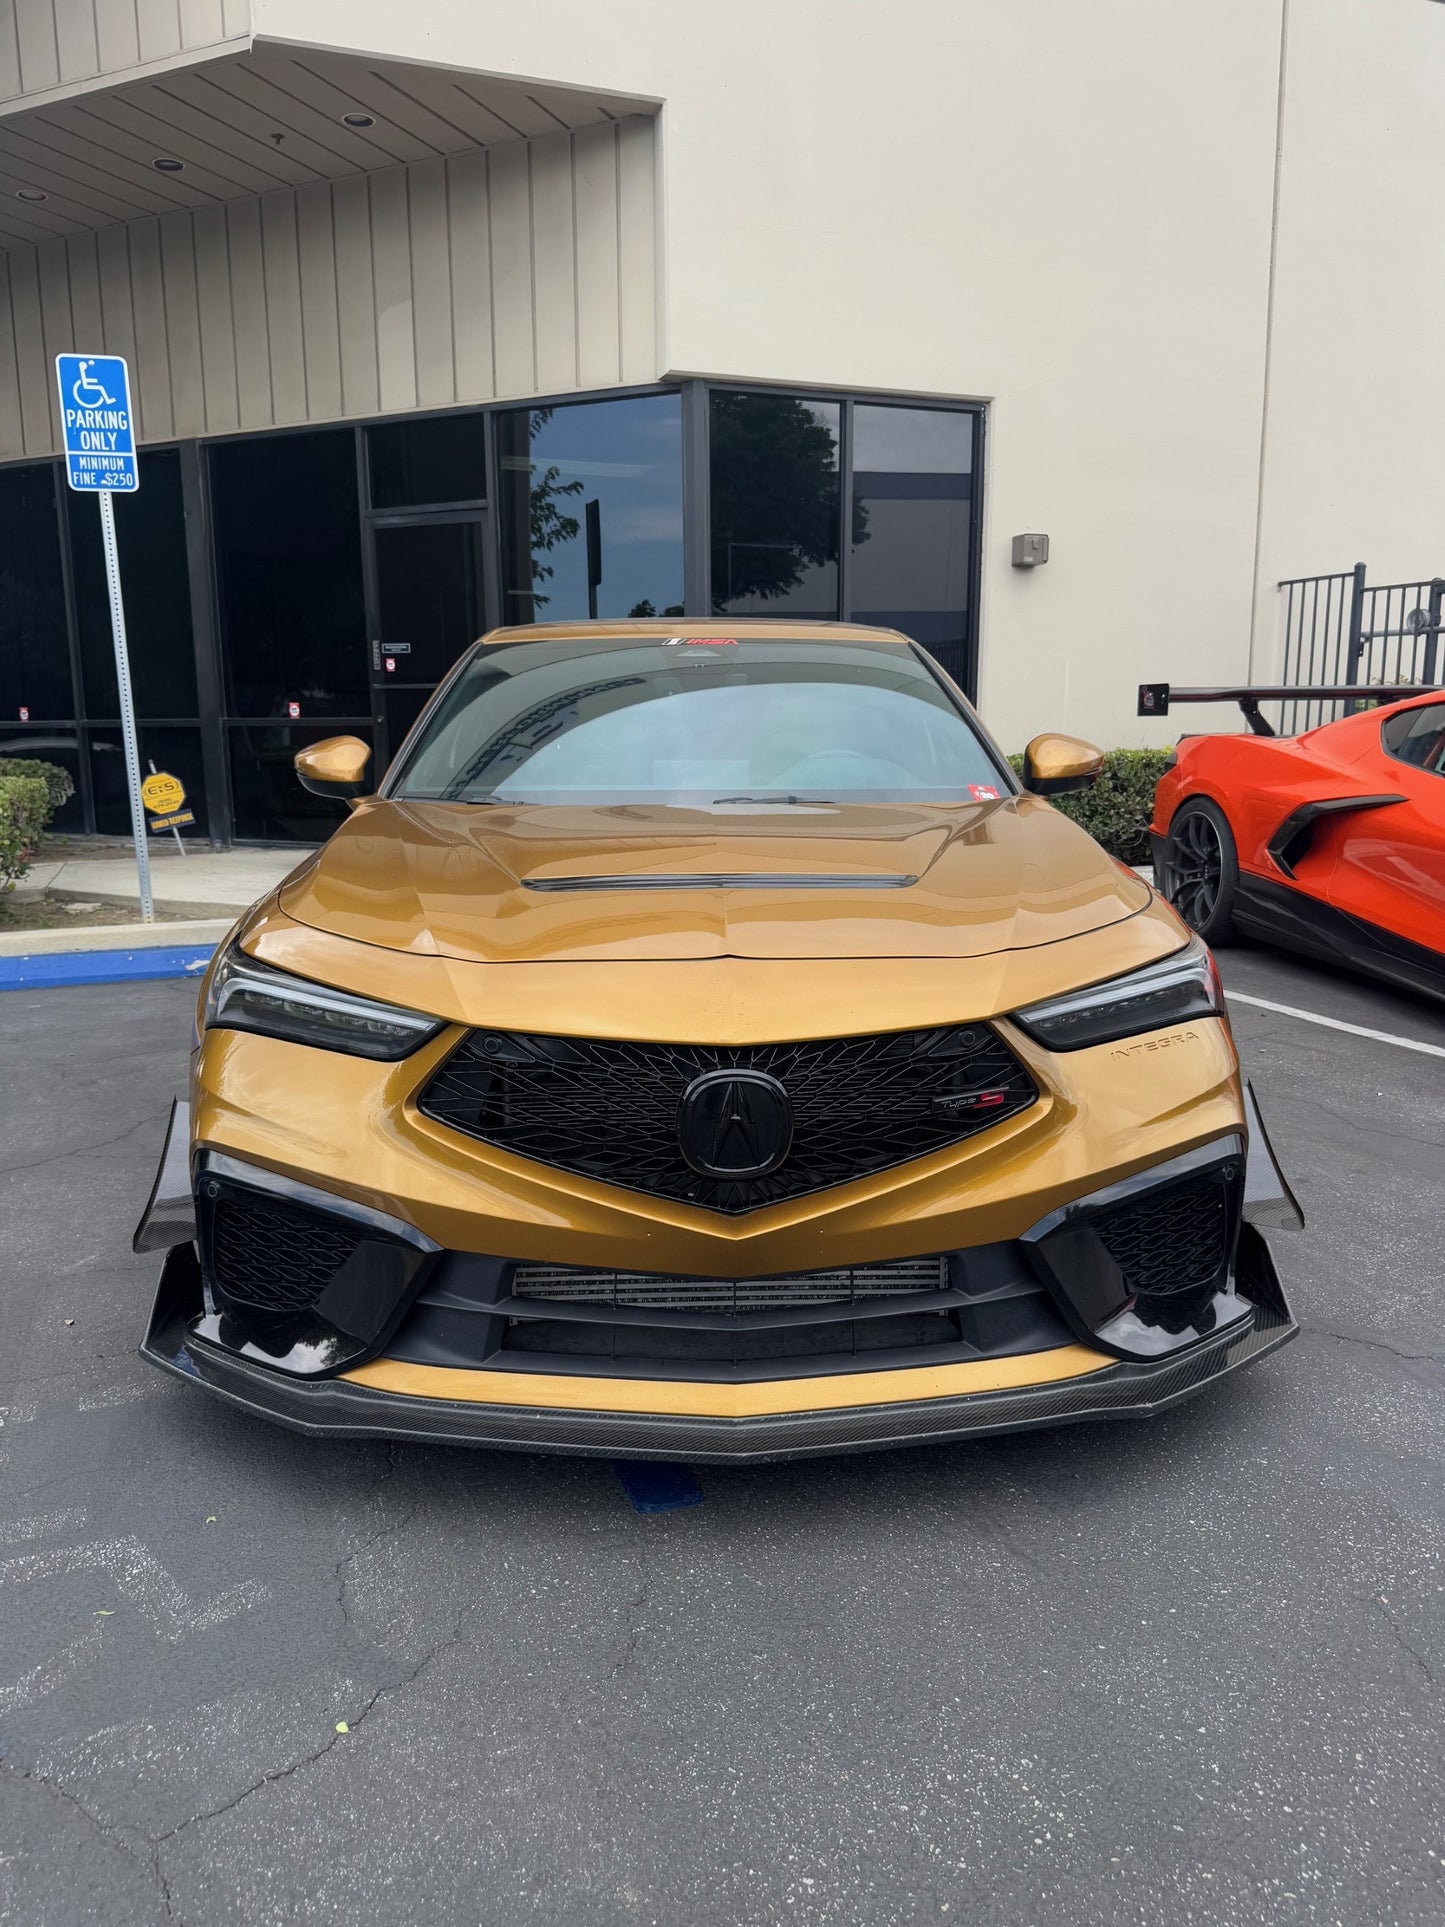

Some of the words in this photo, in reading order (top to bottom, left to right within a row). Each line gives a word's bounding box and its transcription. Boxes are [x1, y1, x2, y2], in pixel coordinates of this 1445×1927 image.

[66, 409, 128, 430] PARKING
[80, 431, 117, 451] ONLY
[79, 457, 125, 470] MINIMUM
[73, 472, 97, 485] FINE
[104, 473, 133, 486] $250
[685, 638, 738, 646] IMSA
[1109, 1031, 1200, 1063] INTEGRA
